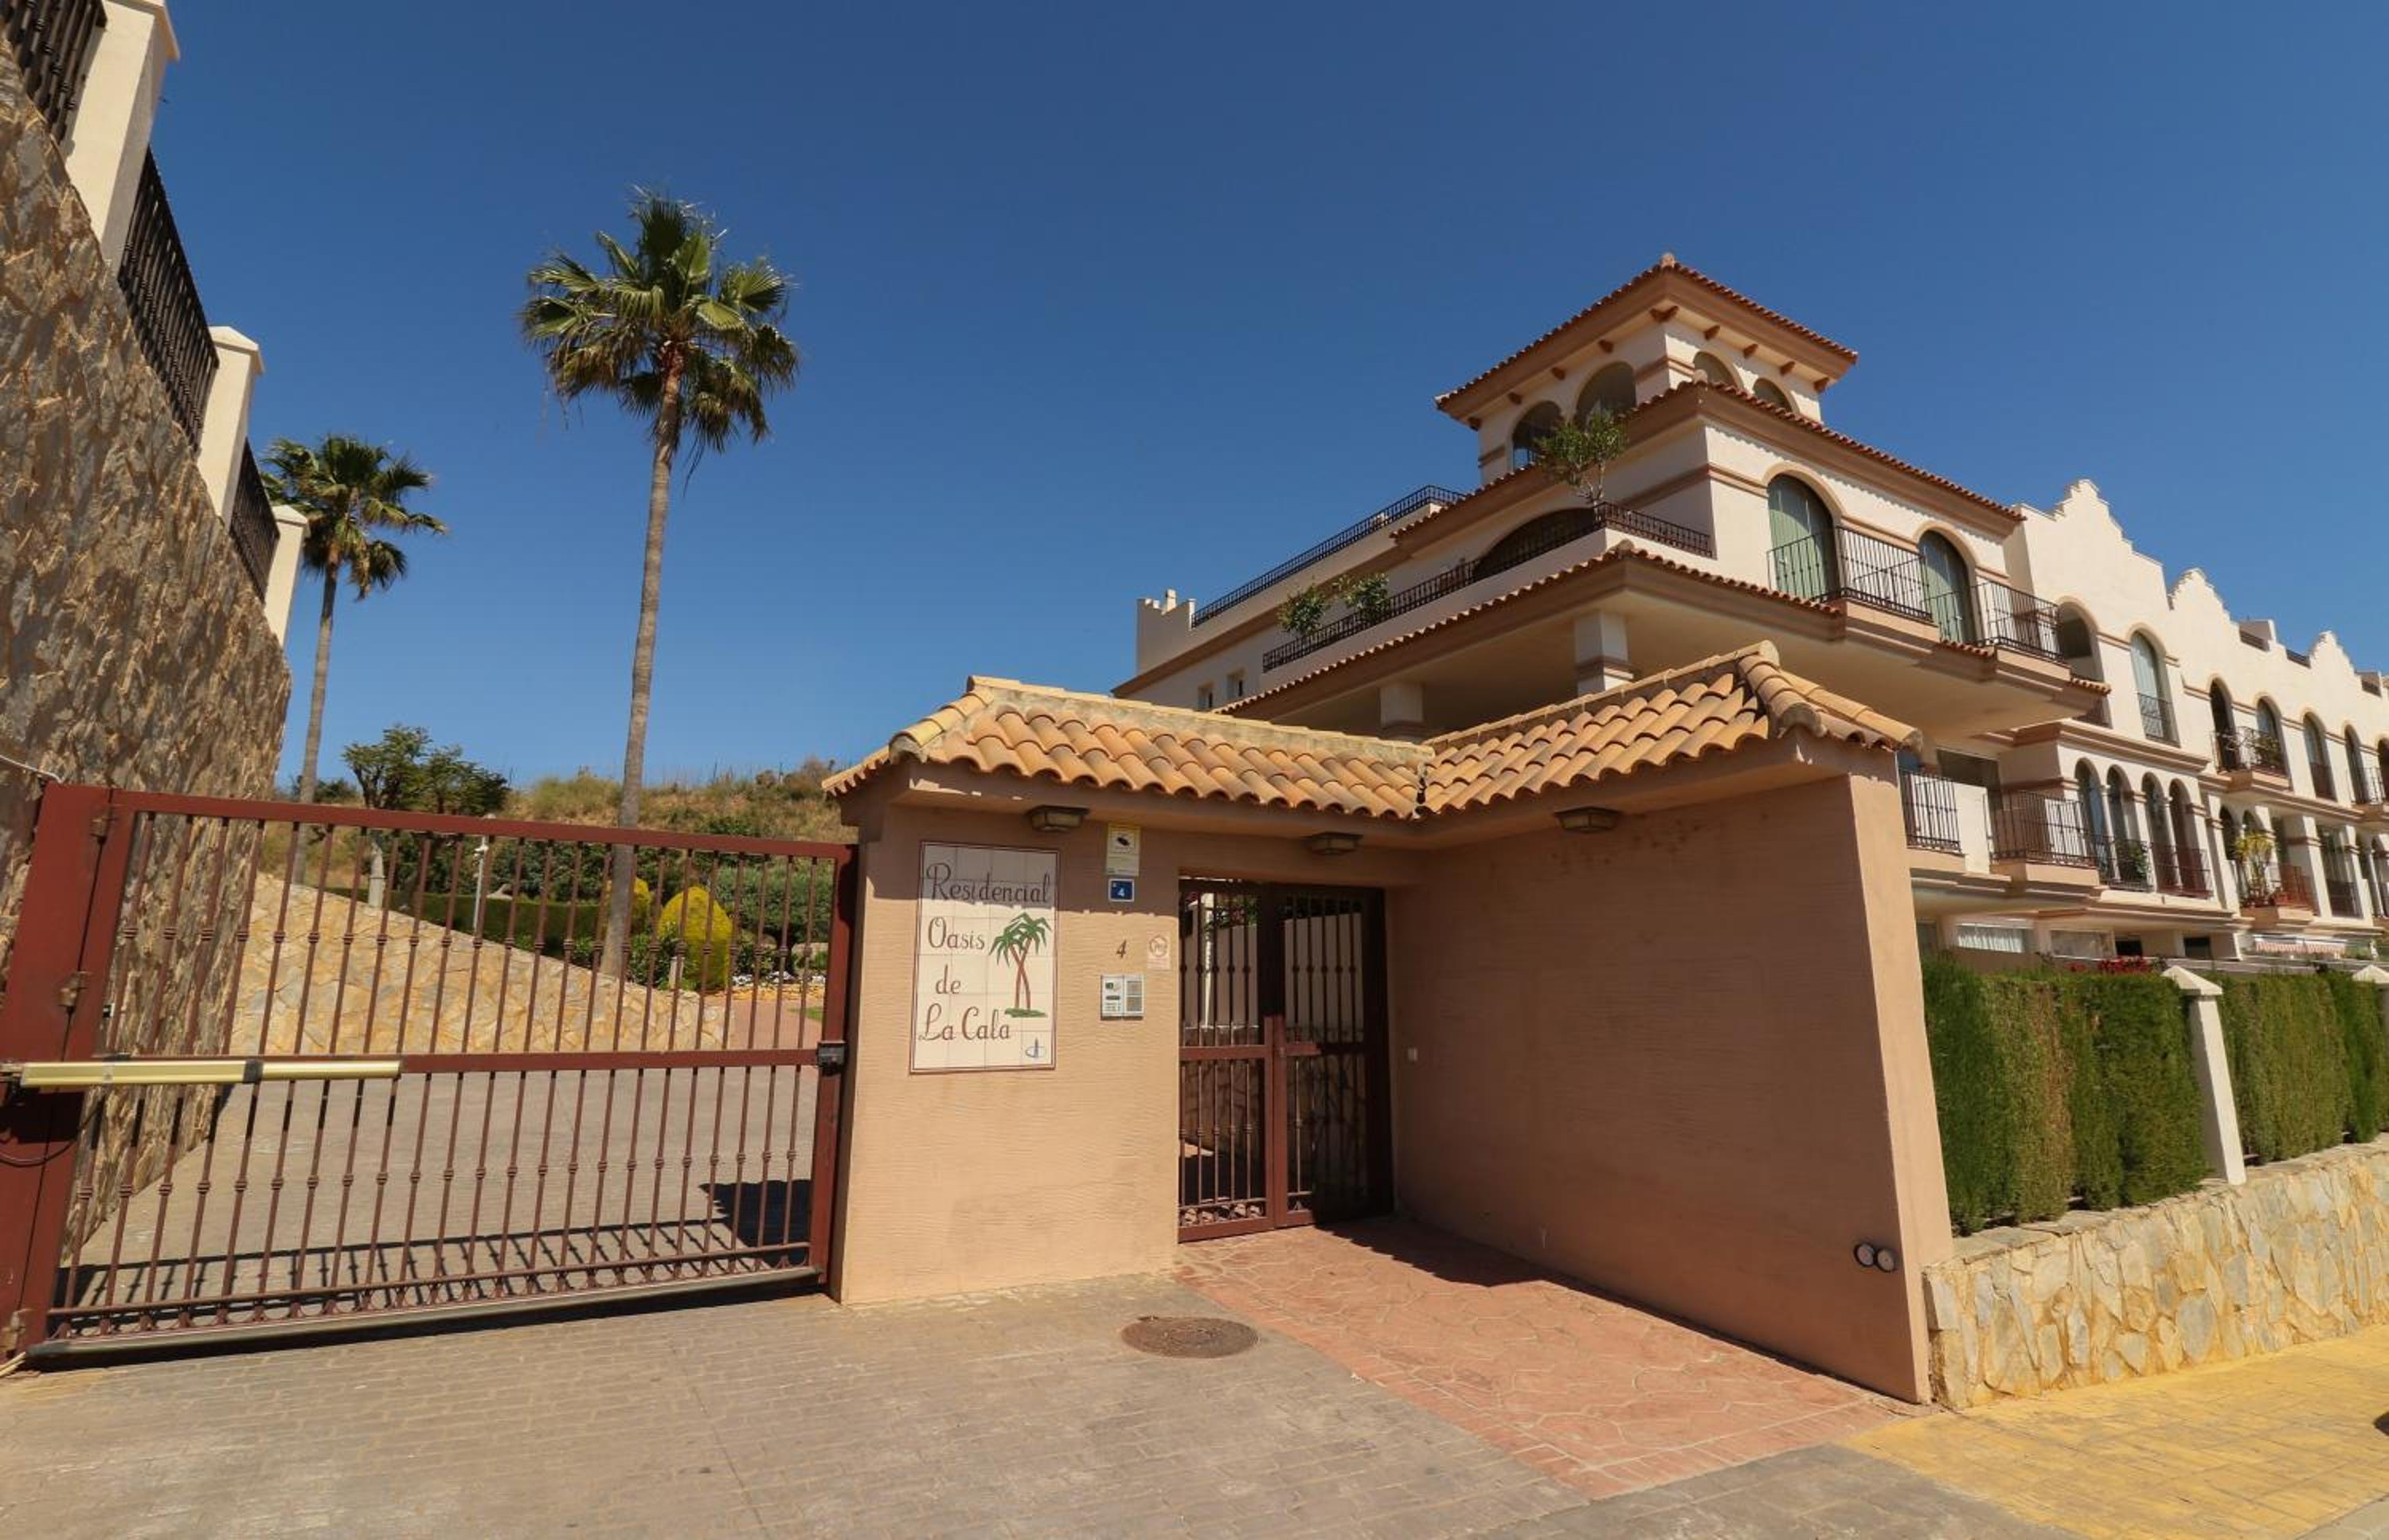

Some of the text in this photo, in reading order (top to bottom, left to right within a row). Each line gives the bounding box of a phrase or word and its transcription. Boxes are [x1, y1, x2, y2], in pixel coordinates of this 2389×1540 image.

[926, 862, 1050, 903] Residencial
[1117, 887, 1125, 897] 4
[928, 917, 985, 949] Oasis
[1116, 939, 1128, 959] 4
[936, 964, 961, 995] de
[918, 1003, 1010, 1042] La Cala
